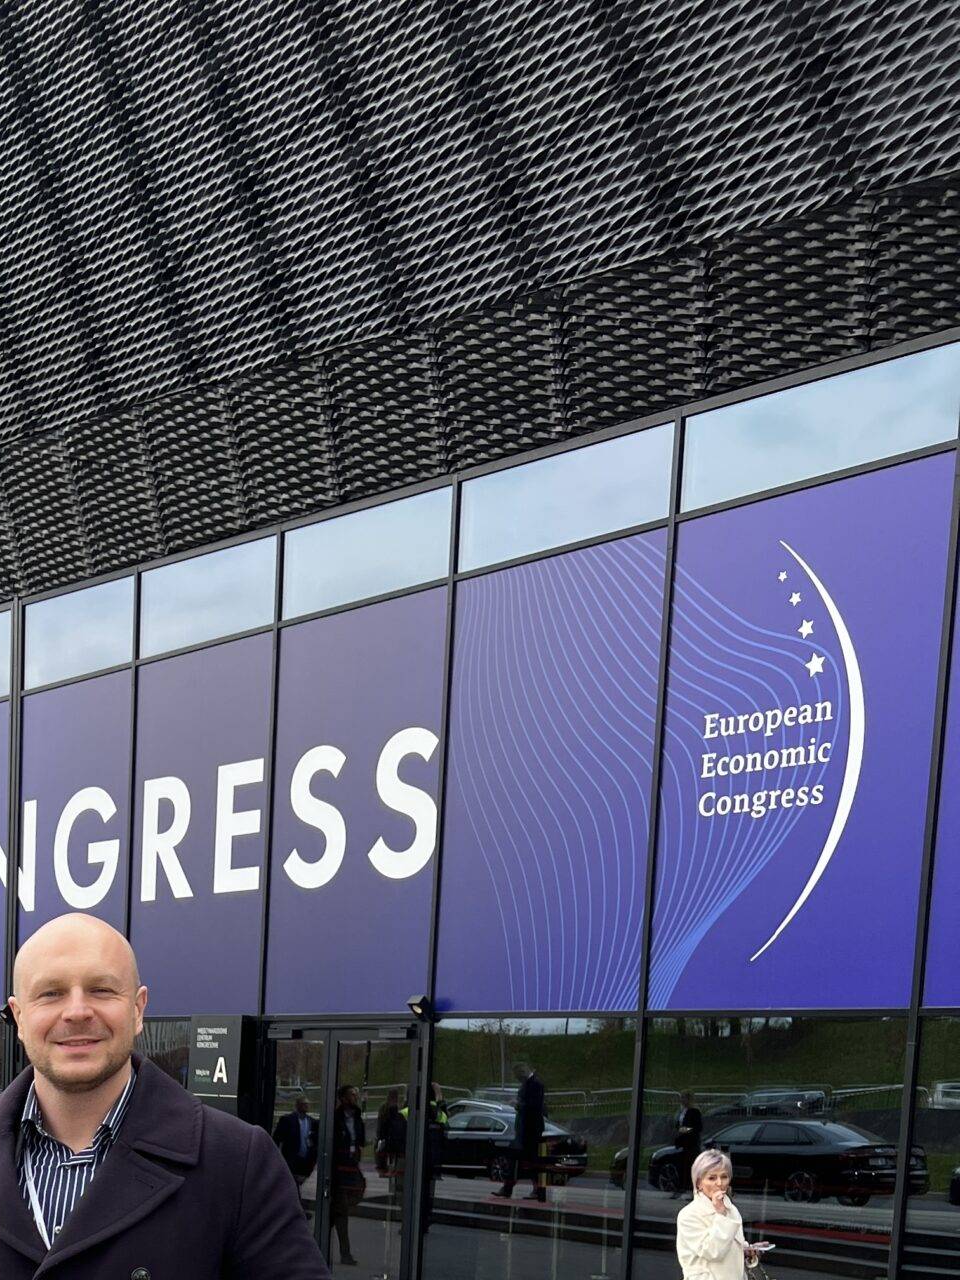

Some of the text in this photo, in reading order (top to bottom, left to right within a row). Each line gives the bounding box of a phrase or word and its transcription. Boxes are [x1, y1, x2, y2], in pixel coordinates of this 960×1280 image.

[703, 701, 833, 738] European
[700, 737, 832, 778] Economic
[698, 784, 825, 818] Congress
[212, 1056, 228, 1083] A
